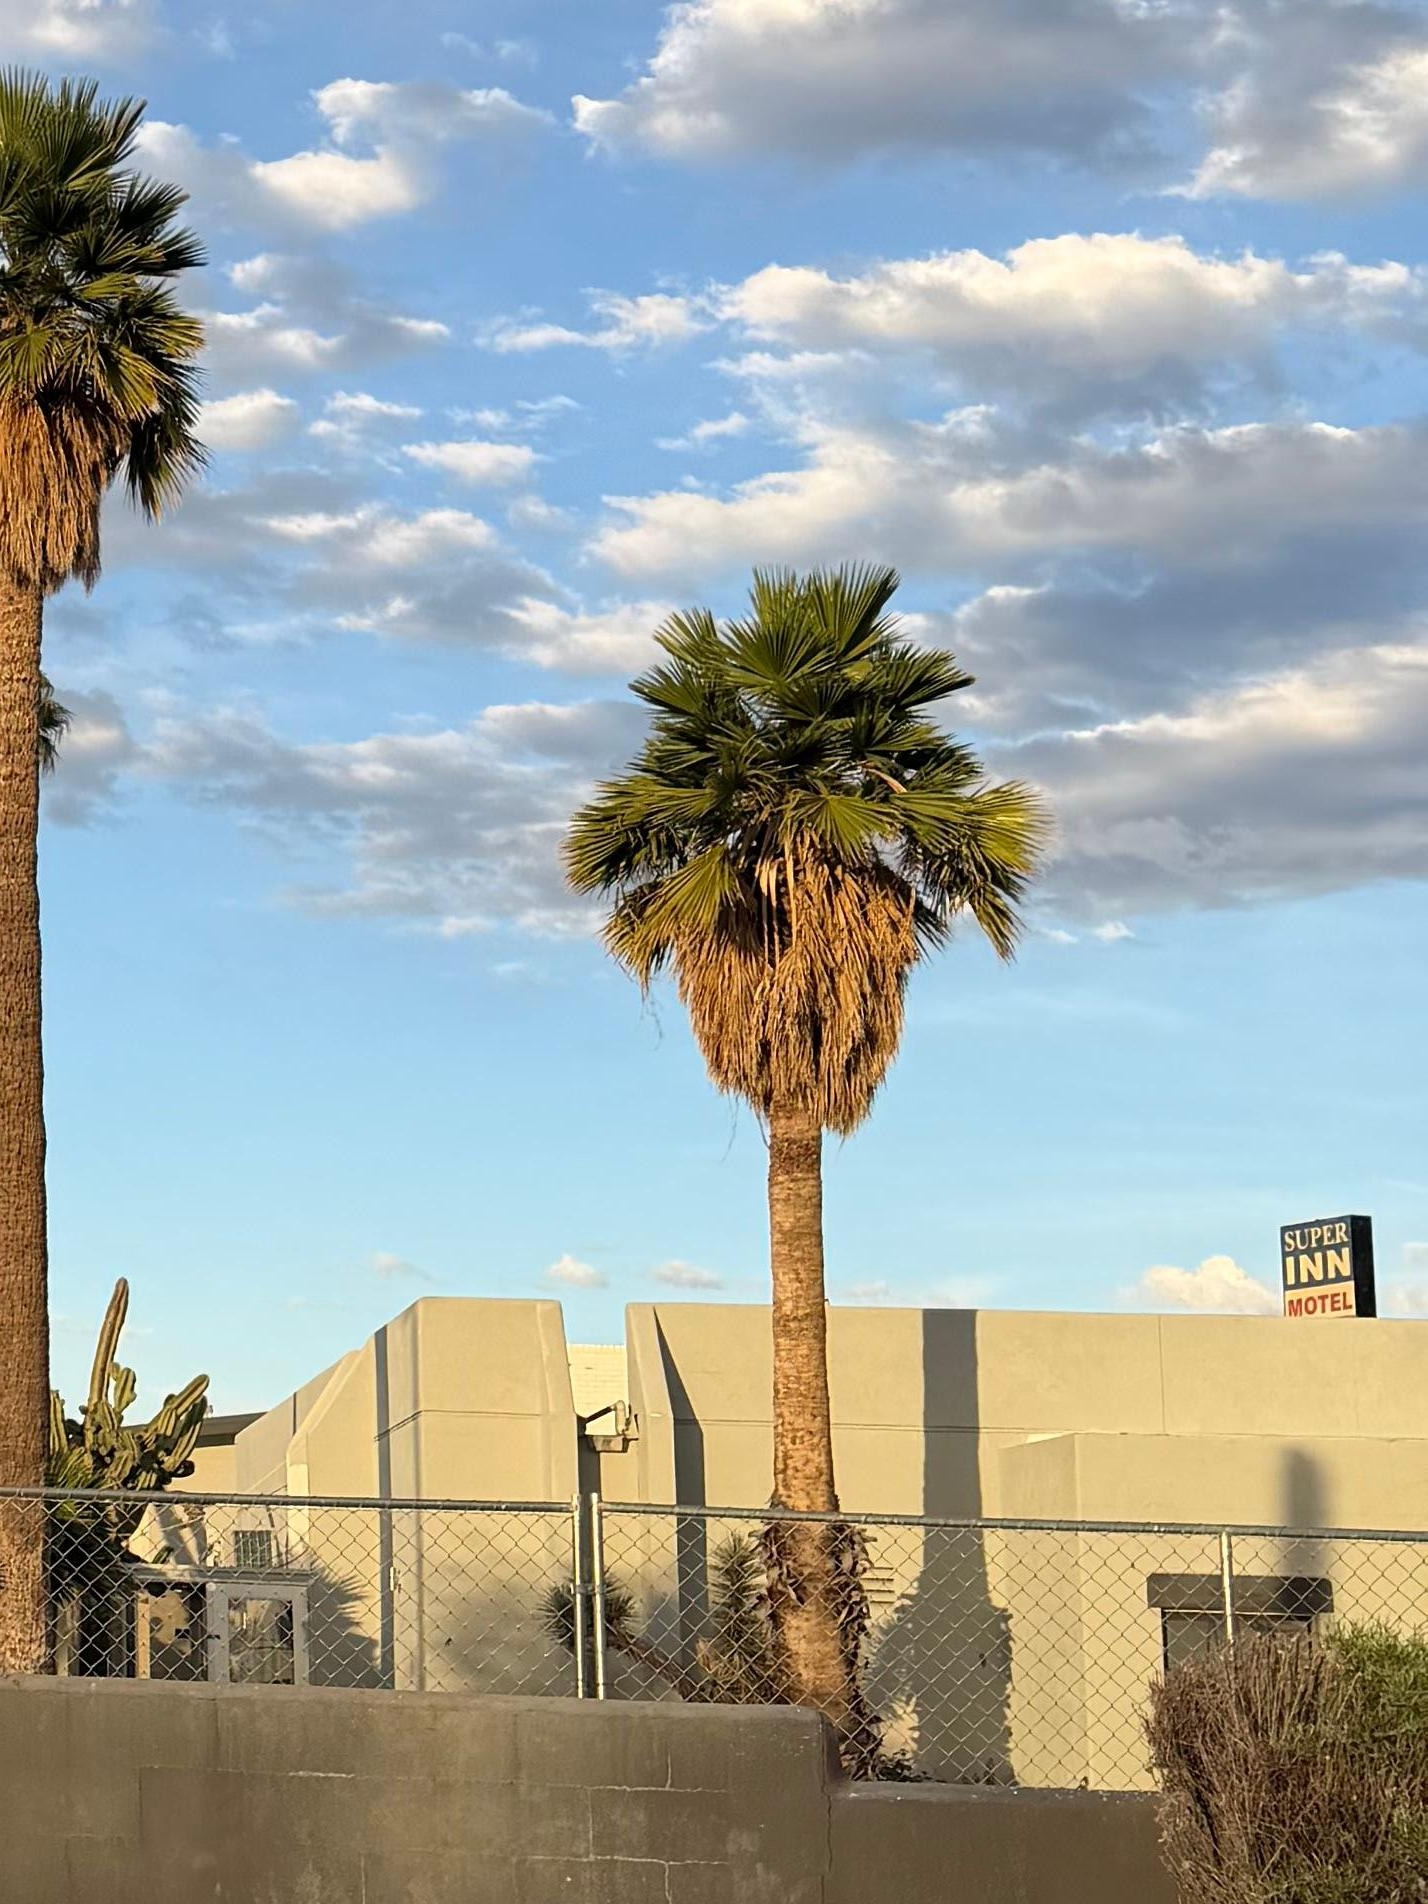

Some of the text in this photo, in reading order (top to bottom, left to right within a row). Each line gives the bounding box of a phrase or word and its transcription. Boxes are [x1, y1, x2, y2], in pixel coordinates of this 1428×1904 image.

[1284, 1222, 1348, 1252] SUPER
[1285, 1247, 1351, 1285] INN
[1288, 1292, 1353, 1317] MOTEL
